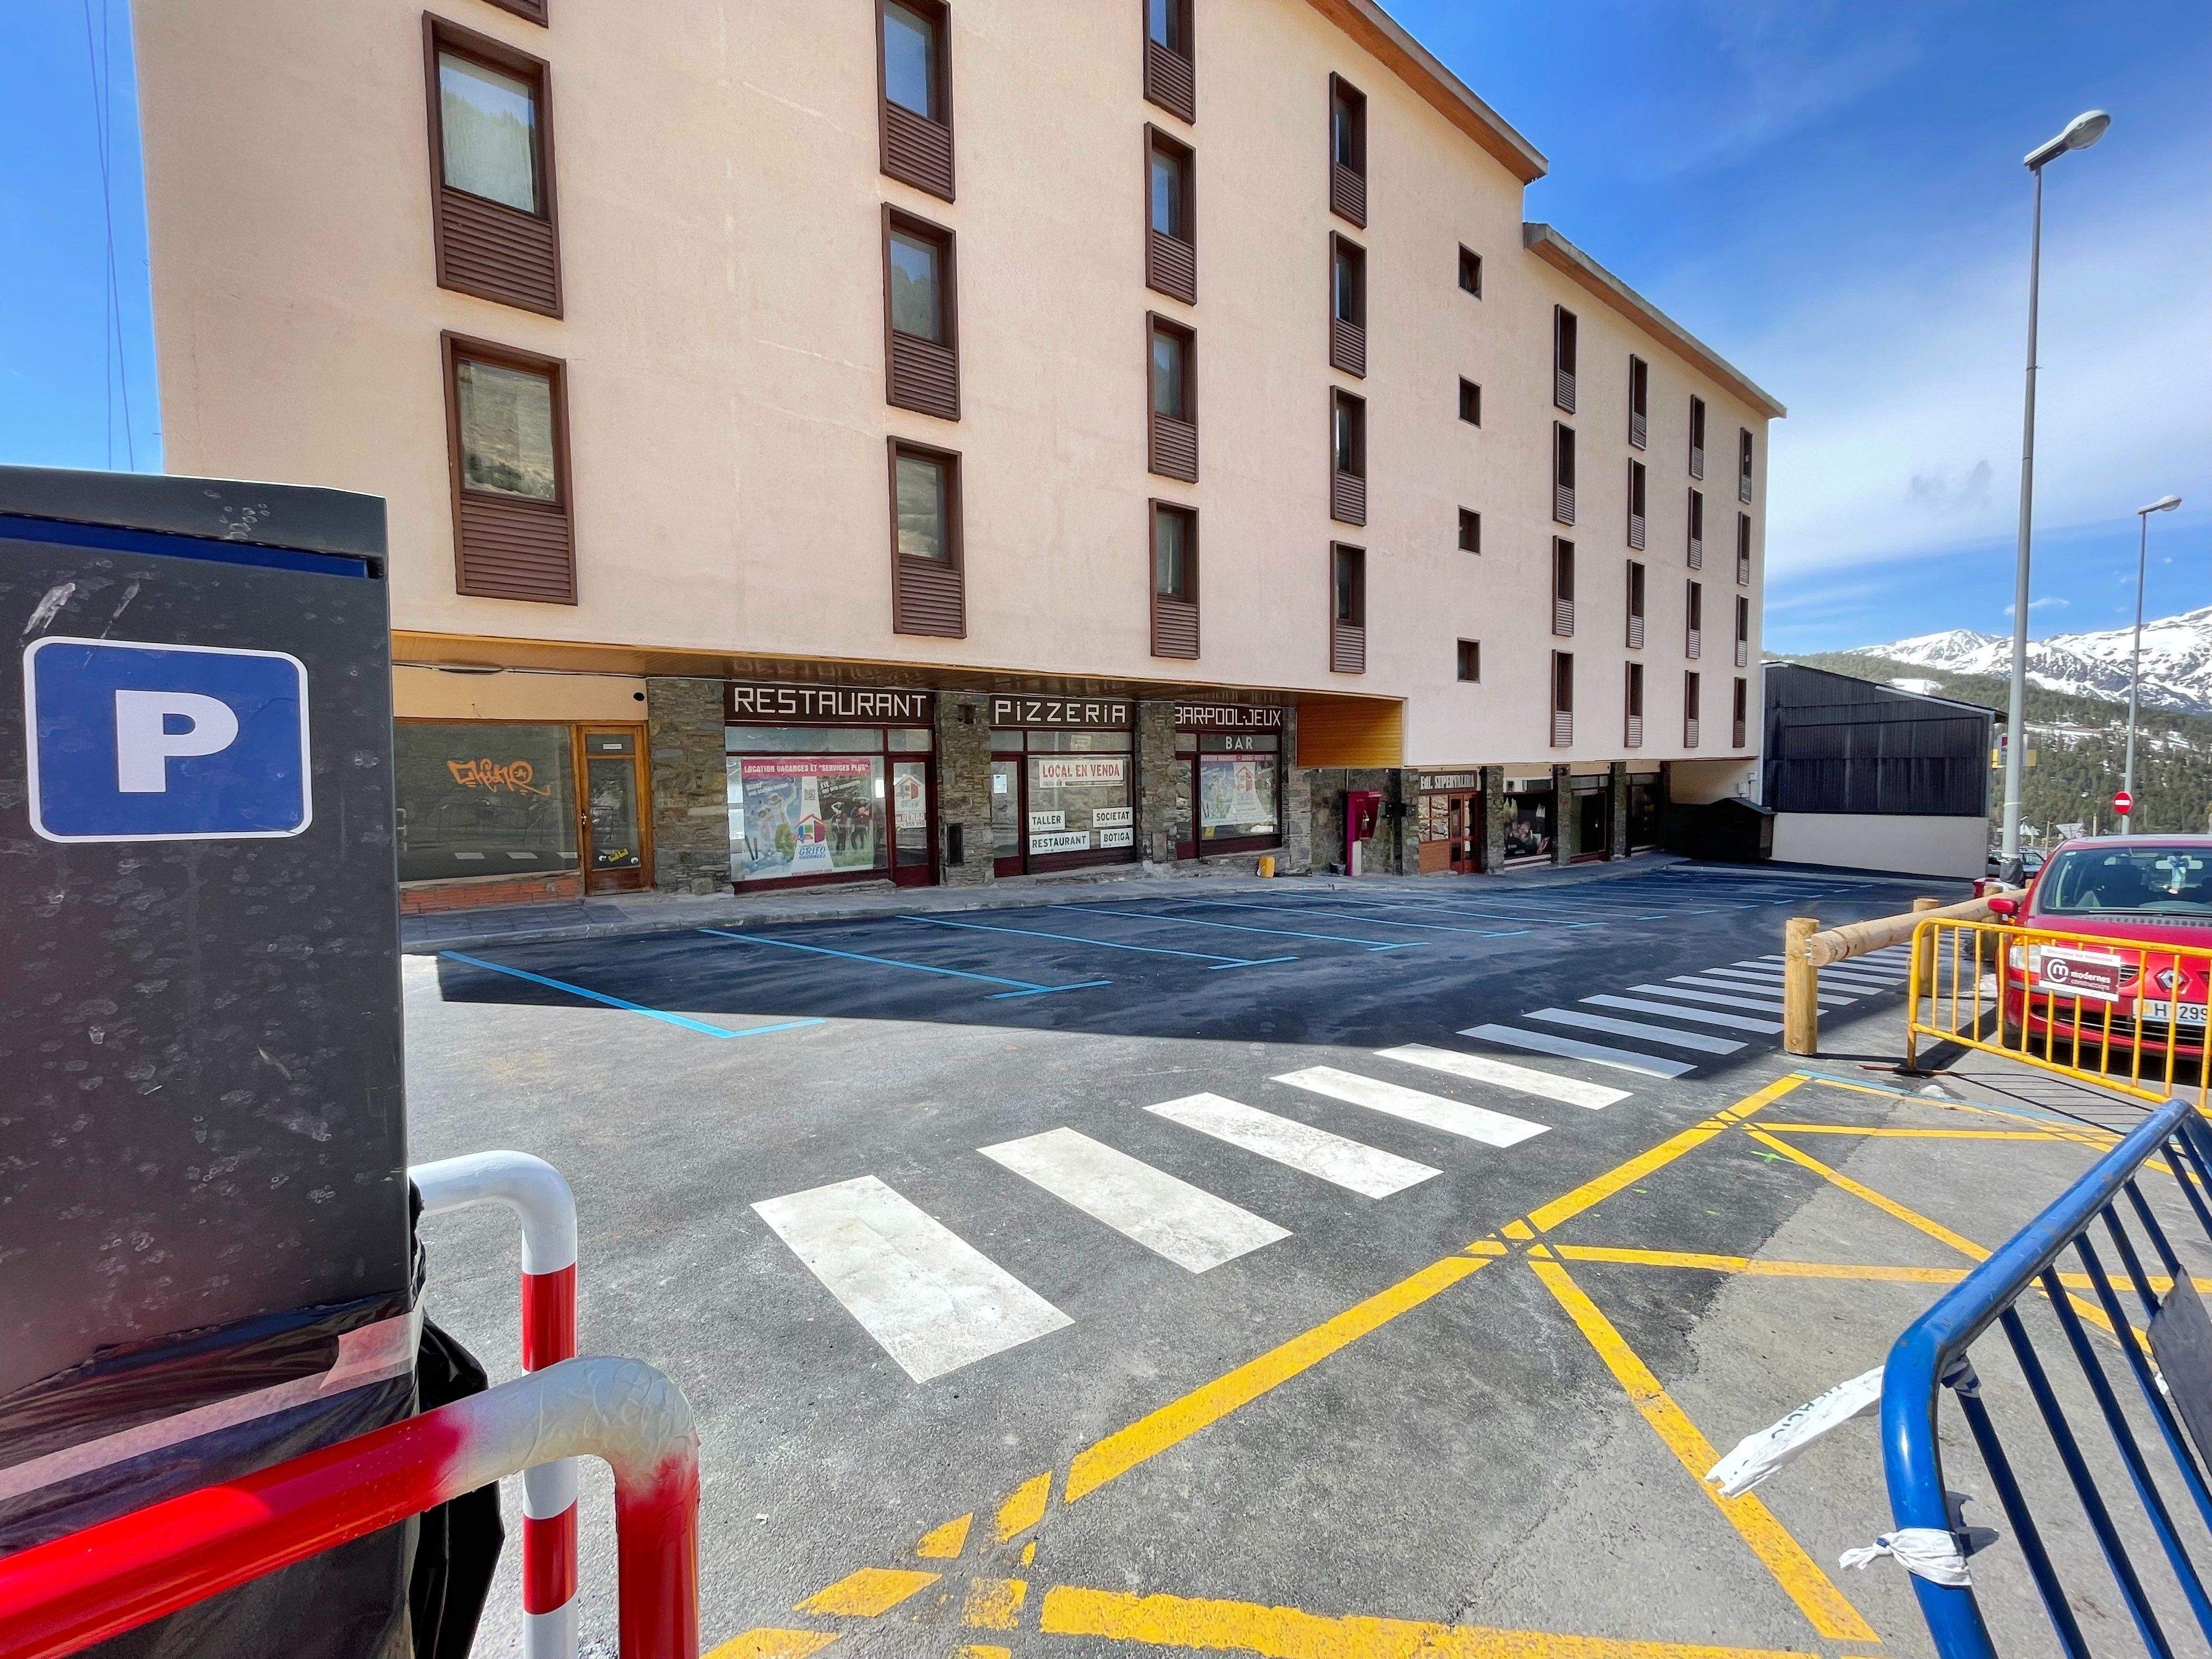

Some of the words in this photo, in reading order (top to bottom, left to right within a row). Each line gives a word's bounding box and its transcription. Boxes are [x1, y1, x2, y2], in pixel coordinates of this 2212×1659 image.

[734, 687, 927, 718] RESTAURANT
[115, 689, 240, 793] P
[1225, 736, 1254, 750] BAR
[1042, 765, 1072, 777] LOCAL
[1076, 764, 1088, 777] EN
[1090, 764, 1120, 776] VENDA
[1032, 815, 1061, 825] TALLER
[1097, 811, 1130, 821] SOCIETAT
[1032, 836, 1086, 849] RESTAURANT
[1104, 832, 1130, 842] BOTIGA
[799, 846, 826, 855] GRIFO
[2070, 971, 2111, 984] modernes
[2154, 1003, 2167, 1017] H
